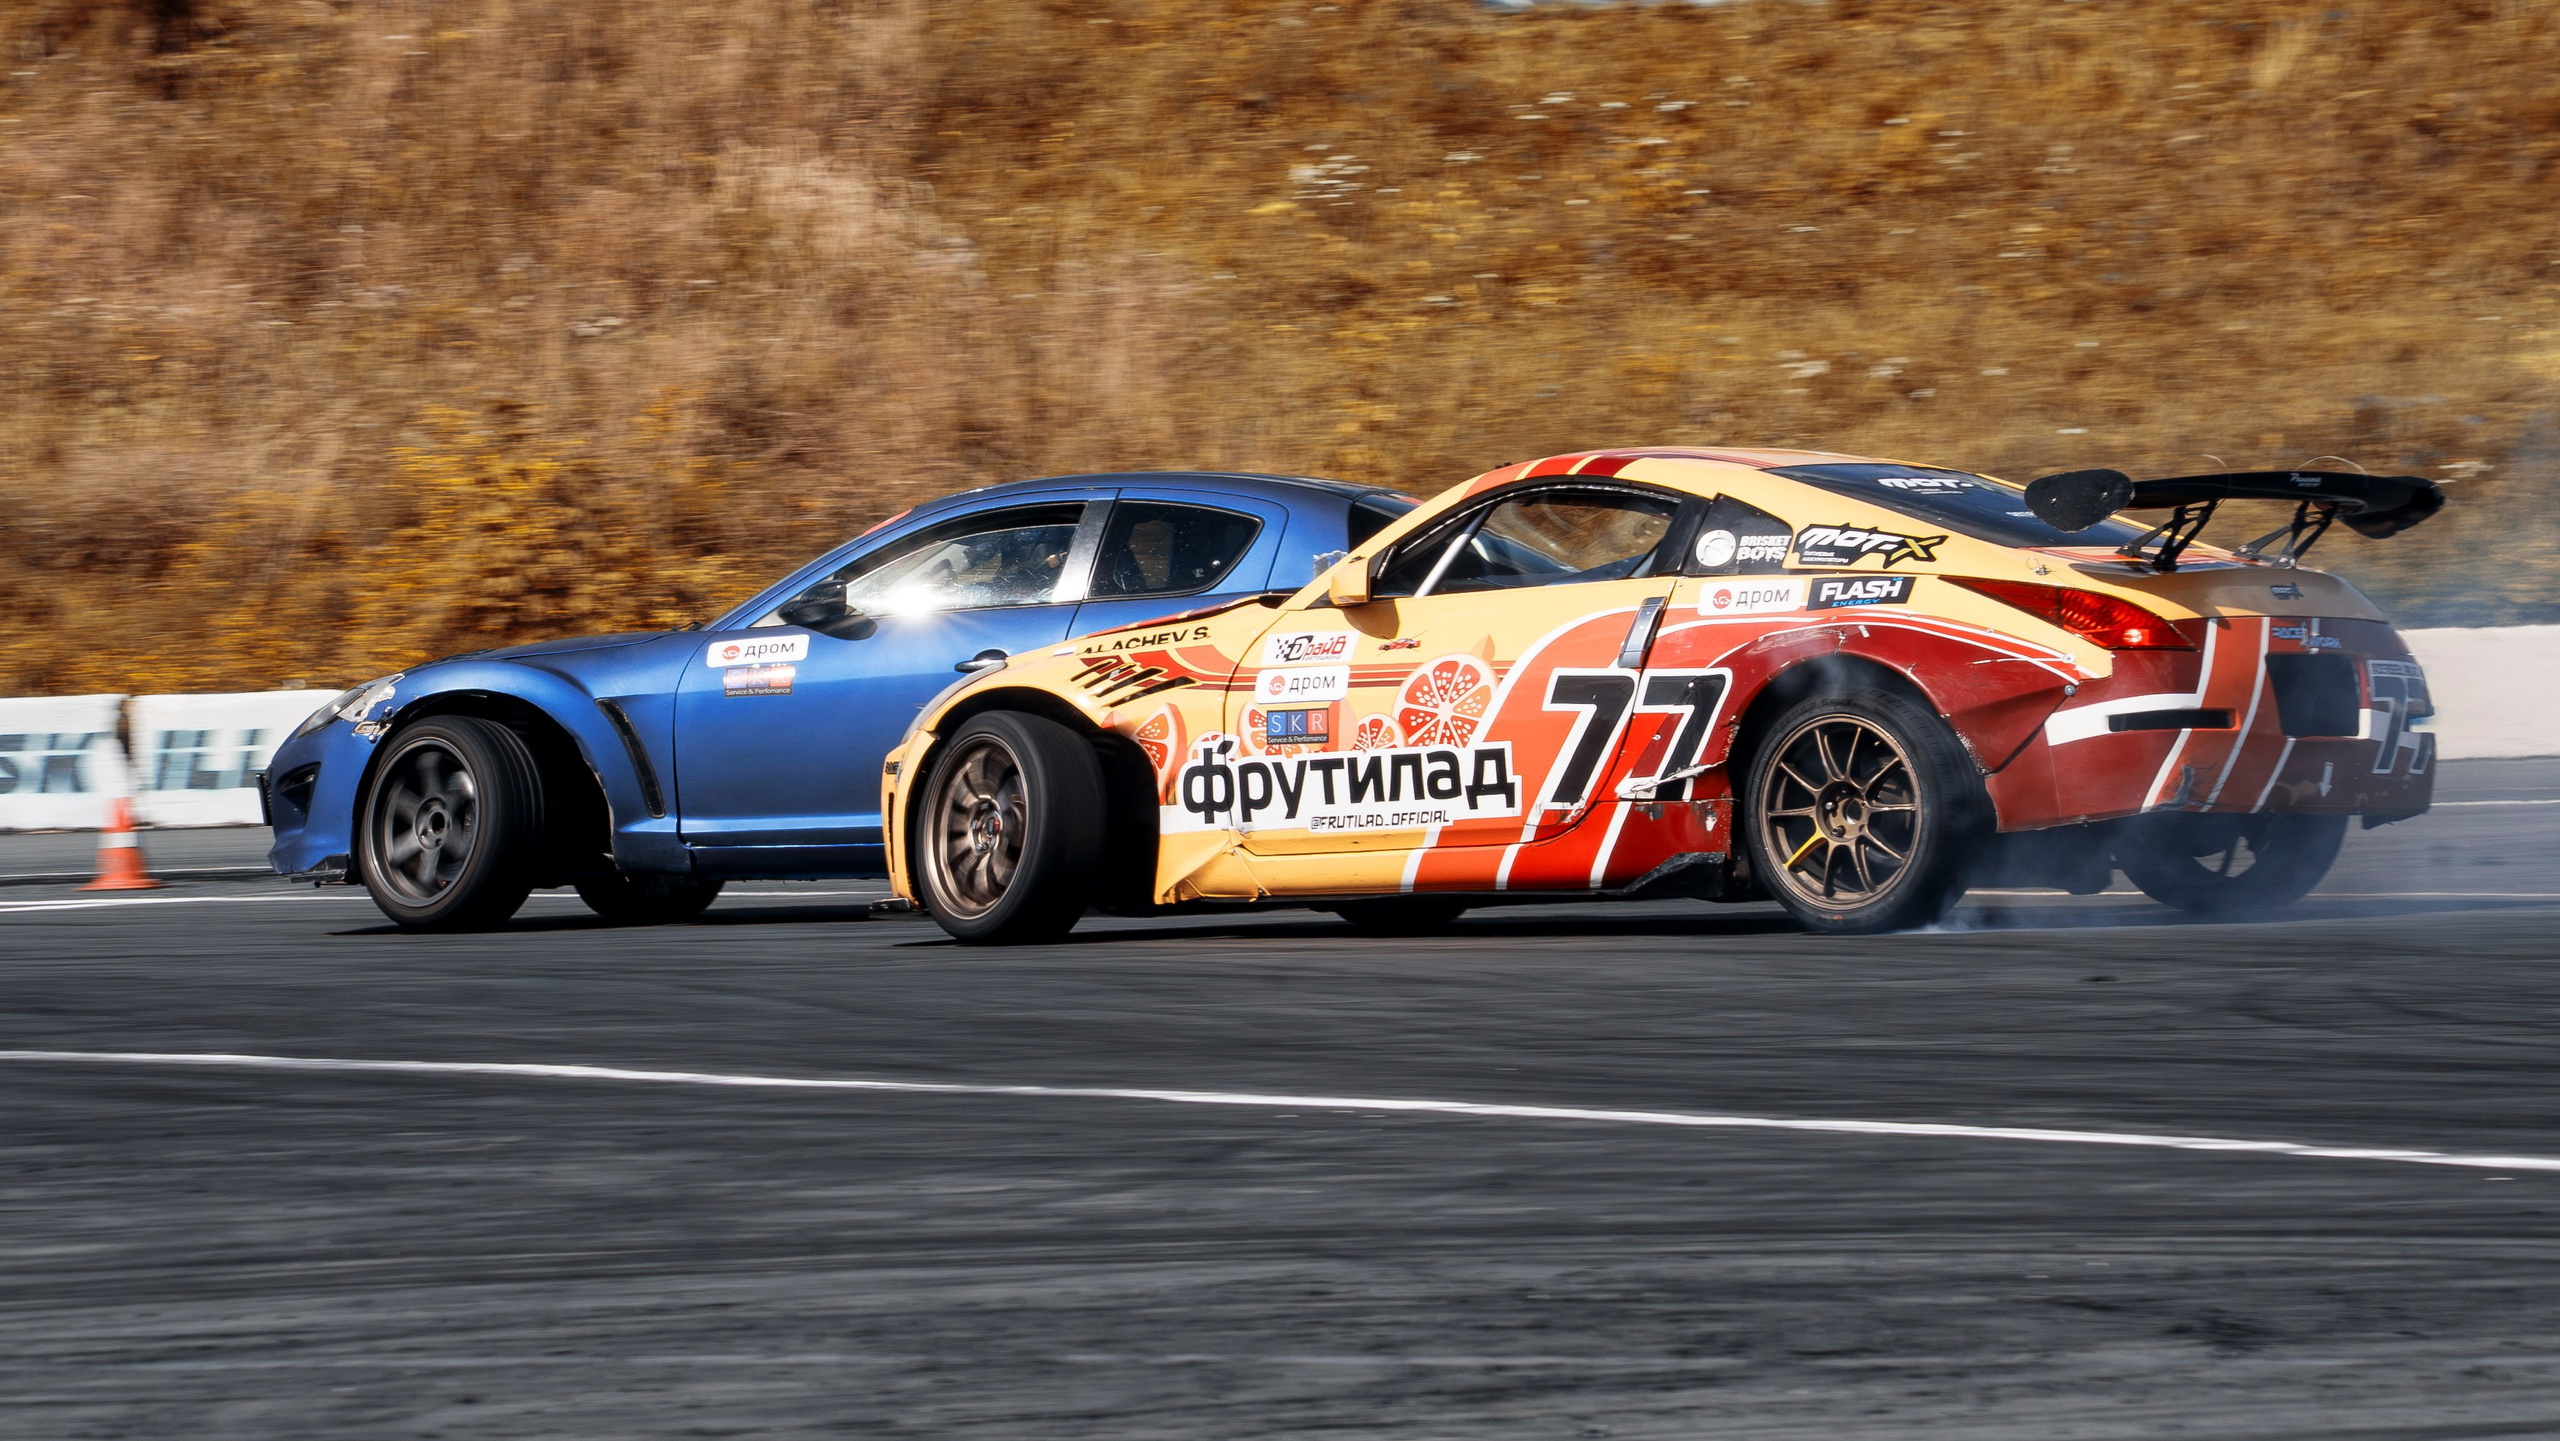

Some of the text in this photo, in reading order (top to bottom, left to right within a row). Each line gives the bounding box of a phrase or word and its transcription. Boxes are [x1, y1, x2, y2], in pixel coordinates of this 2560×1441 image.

[1740, 535, 1792, 547] BRISKET
[1799, 528, 1941, 561] MOT-X
[1736, 546, 1787, 564] BOYS
[1736, 589, 1790, 609] дром
[1819, 580, 1903, 602] FLASH
[1832, 599, 1880, 607] ENERGY
[745, 643, 794, 658] дром
[1289, 676, 1336, 695] дром
[1271, 713, 1324, 733] SKR
[1546, 669, 1731, 807] 77
[1311, 810, 1449, 829] @FRUTILAD_OFFICIAL
